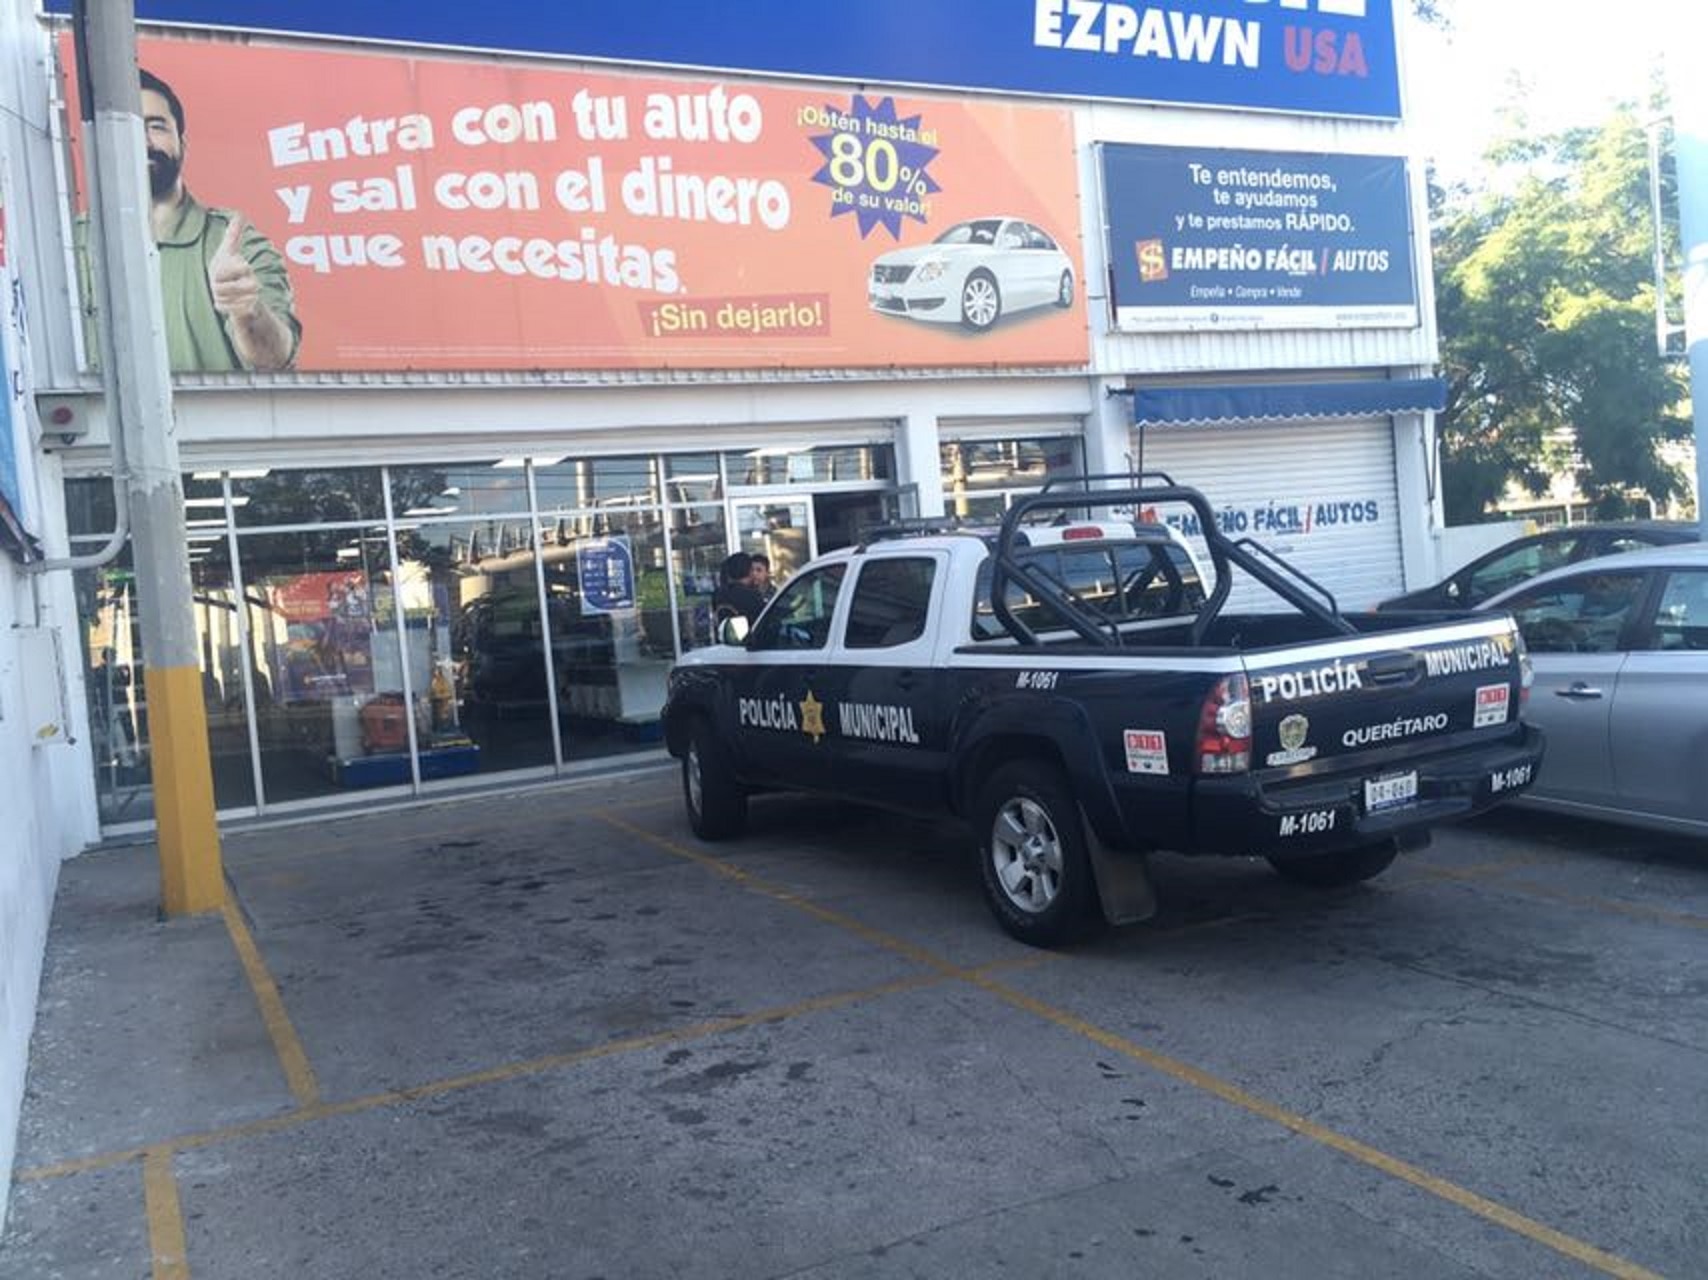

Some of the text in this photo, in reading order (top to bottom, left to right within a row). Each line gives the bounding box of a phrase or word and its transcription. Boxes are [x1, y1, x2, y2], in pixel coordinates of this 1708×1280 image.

[1034, 0, 1370, 78] EZPAWN USA
[268, 85, 762, 167] Entra con tu auto
[797, 105, 937, 145] ¡Obtén hasta el
[829, 132, 928, 196] 80%
[1188, 163, 1337, 193] Te entendemos,
[275, 156, 791, 231] y sal con el dinero
[832, 187, 931, 216] de su valor!
[1213, 188, 1318, 210] te ayudamos
[1175, 208, 1355, 232] y te prestamos RÁPIDO.
[285, 226, 687, 295] que necesitas.
[1171, 243, 1262, 271] EMPEÑO
[1265, 243, 1317, 273] FÁCIL
[1333, 249, 1389, 272] AUTOS
[652, 300, 824, 337] ¡Sin dejarlo!
[1254, 501, 1303, 531] FÁCIL
[1315, 502, 1378, 526] AUTOS
[1015, 671, 1059, 689] M-1061
[1262, 641, 1510, 703] POLICÍA MUNICIPAL
[740, 693, 919, 743] POLICÍA MUNICIPAL
[1342, 713, 1448, 747] QUERÉTARO
[1492, 764, 1532, 793] M-1061
[1280, 809, 1335, 836] M-1061
